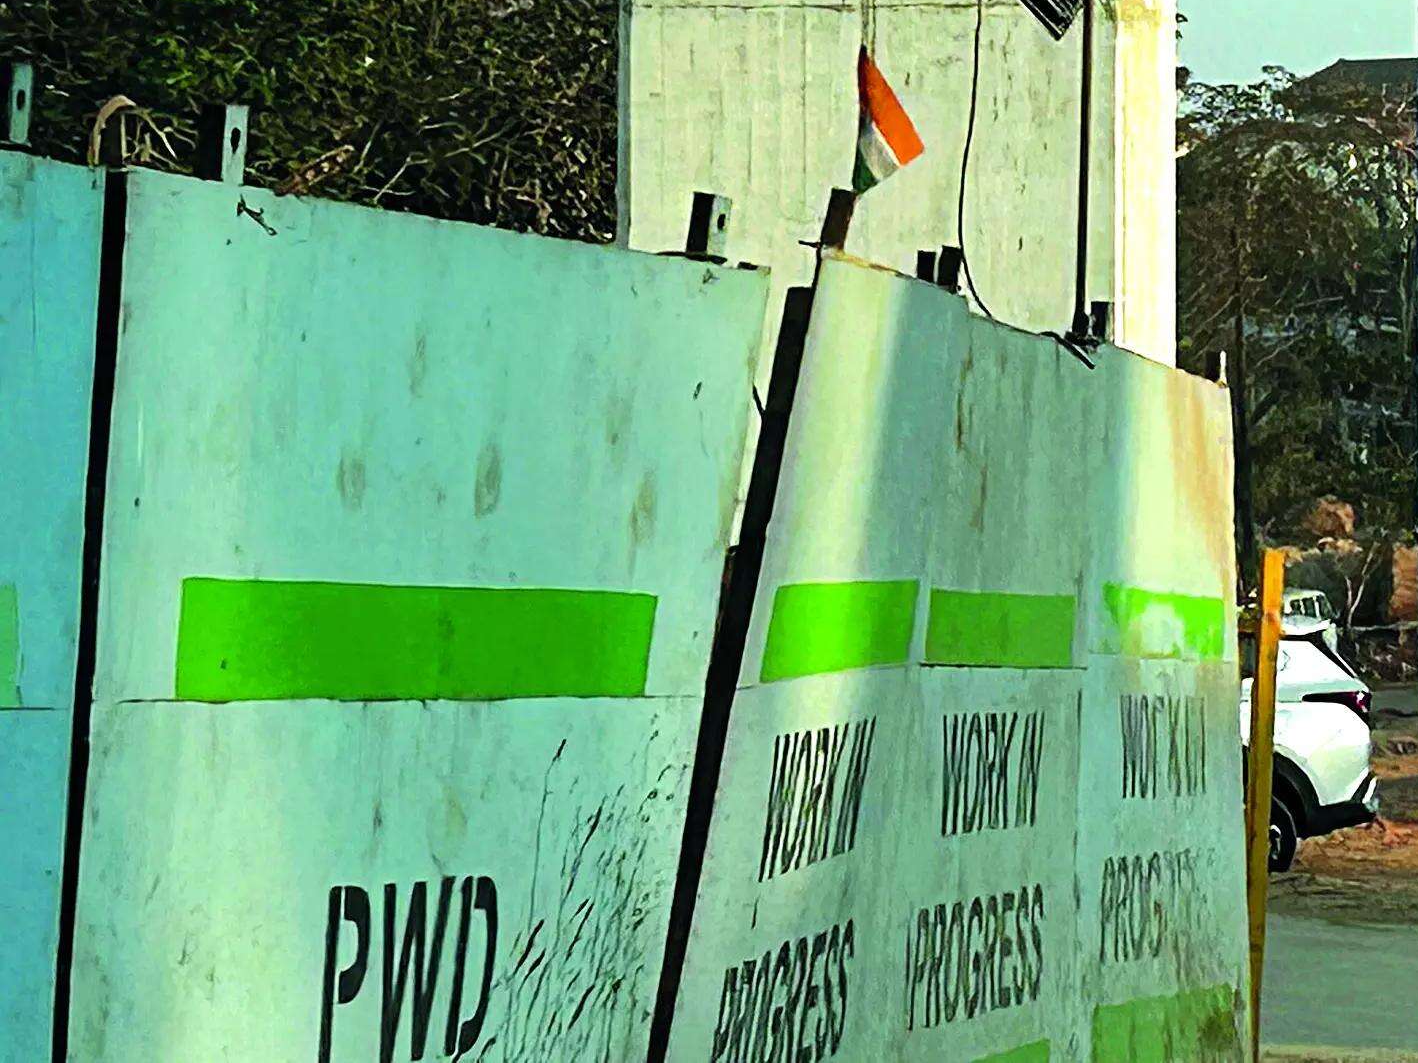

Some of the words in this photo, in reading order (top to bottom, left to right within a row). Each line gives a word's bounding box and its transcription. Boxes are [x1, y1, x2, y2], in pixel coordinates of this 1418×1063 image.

[758, 721, 850, 883] WORK
[941, 711, 1019, 837] WORK
[317, 874, 499, 1063] PWD
[710, 917, 855, 1063] PROGRESS
[907, 883, 1045, 1032] PROGRESS
